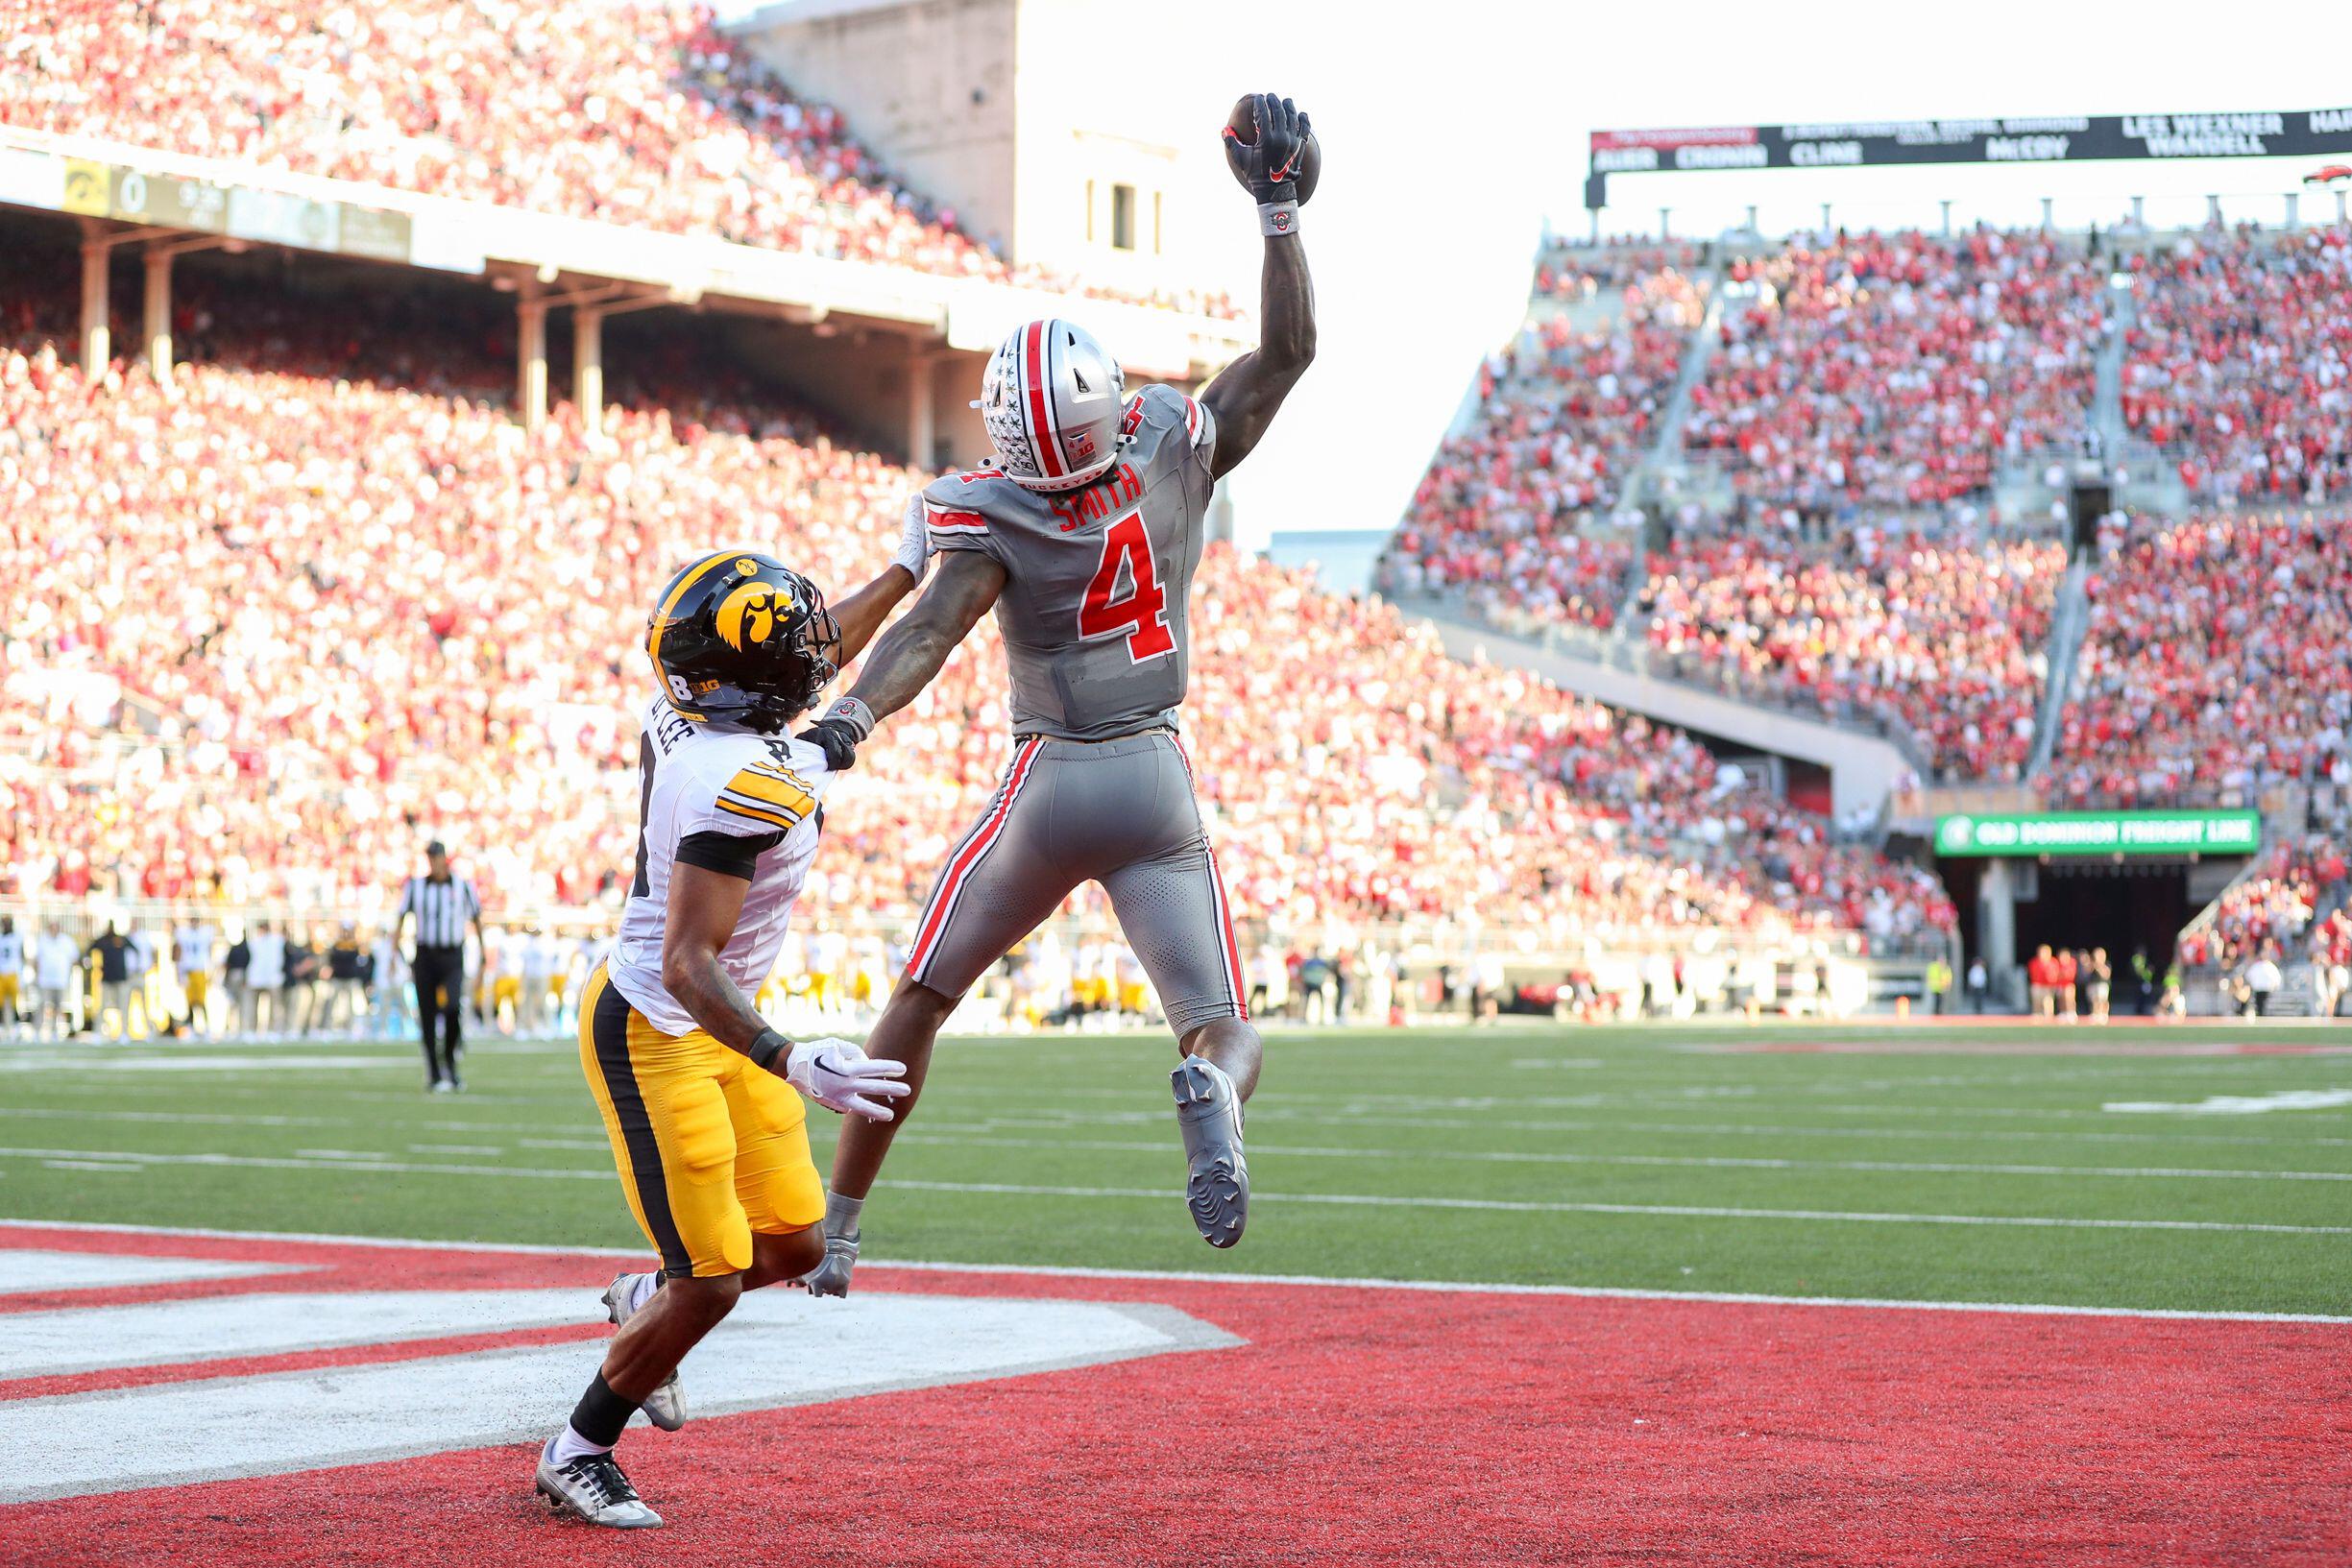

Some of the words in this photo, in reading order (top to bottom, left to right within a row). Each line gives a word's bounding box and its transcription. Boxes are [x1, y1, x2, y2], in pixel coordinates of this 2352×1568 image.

[2122, 116, 2170, 138] LES
[2171, 112, 2285, 135] WEXNER
[2145, 133, 2267, 157] WANDELL
[1019, 470, 1103, 491] BUCKEYES
[1048, 463, 1142, 532] SMITH
[1077, 505, 1179, 665] 4
[667, 674, 693, 701] 8
[1976, 822, 2018, 845] OLD
[2020, 821, 2118, 845] DOMINION
[2121, 820, 2205, 843] FREIGHT
[2206, 819, 2253, 843] LINE
